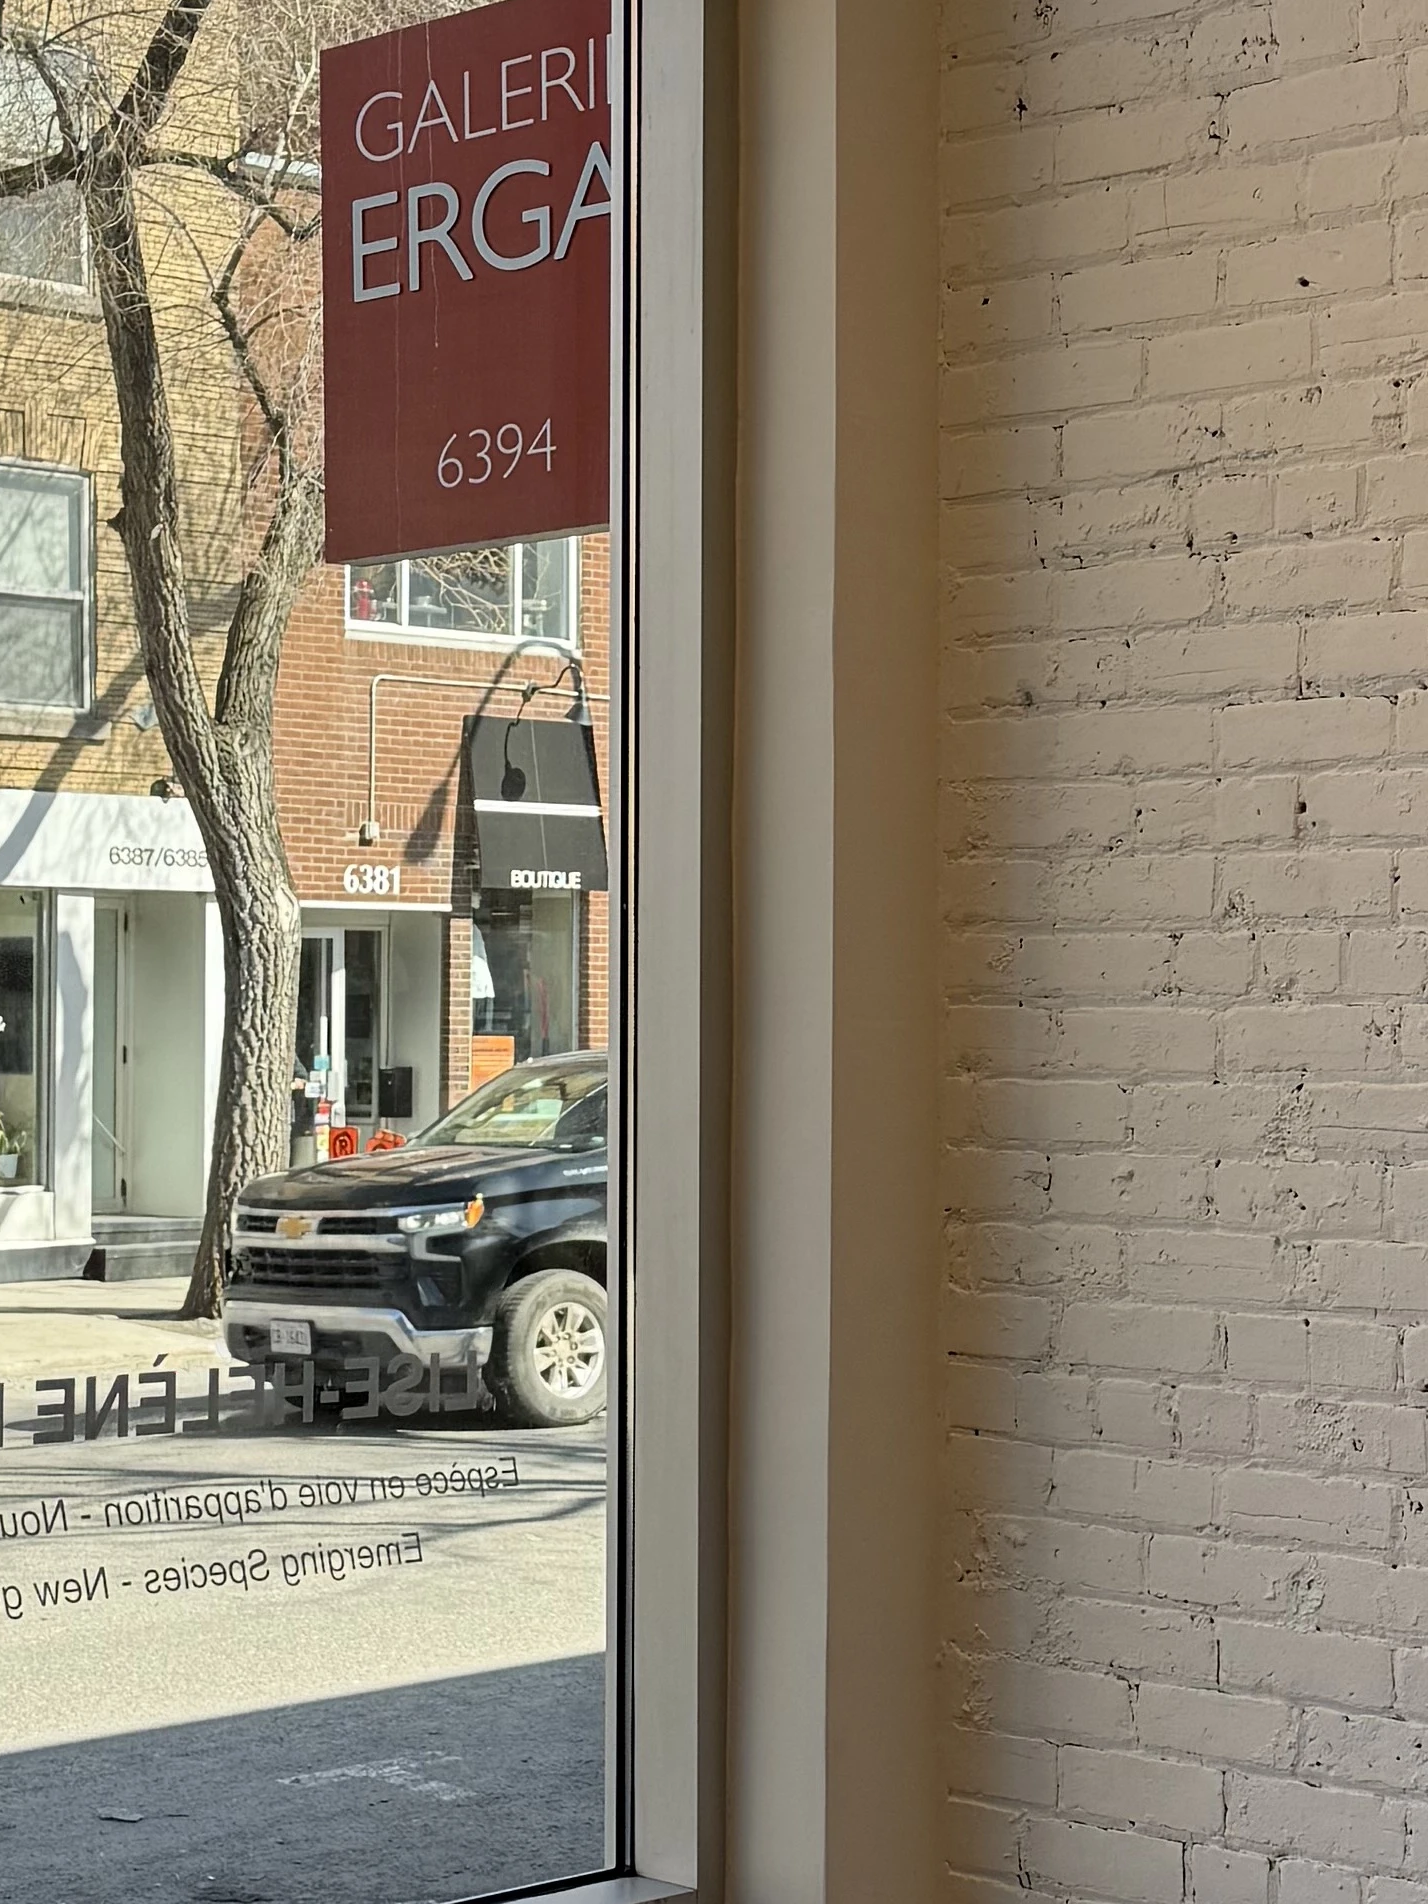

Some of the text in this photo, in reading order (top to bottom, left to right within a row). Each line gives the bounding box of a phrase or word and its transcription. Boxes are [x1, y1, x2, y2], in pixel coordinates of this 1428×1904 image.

[355, 33, 612, 162] GALERI
[352, 141, 612, 303] ERGA
[437, 417, 557, 488] 6394
[109, 846, 208, 868] 6387/6385
[343, 864, 401, 895] 6381
[510, 869, 582, 889] BOUTIQUE
